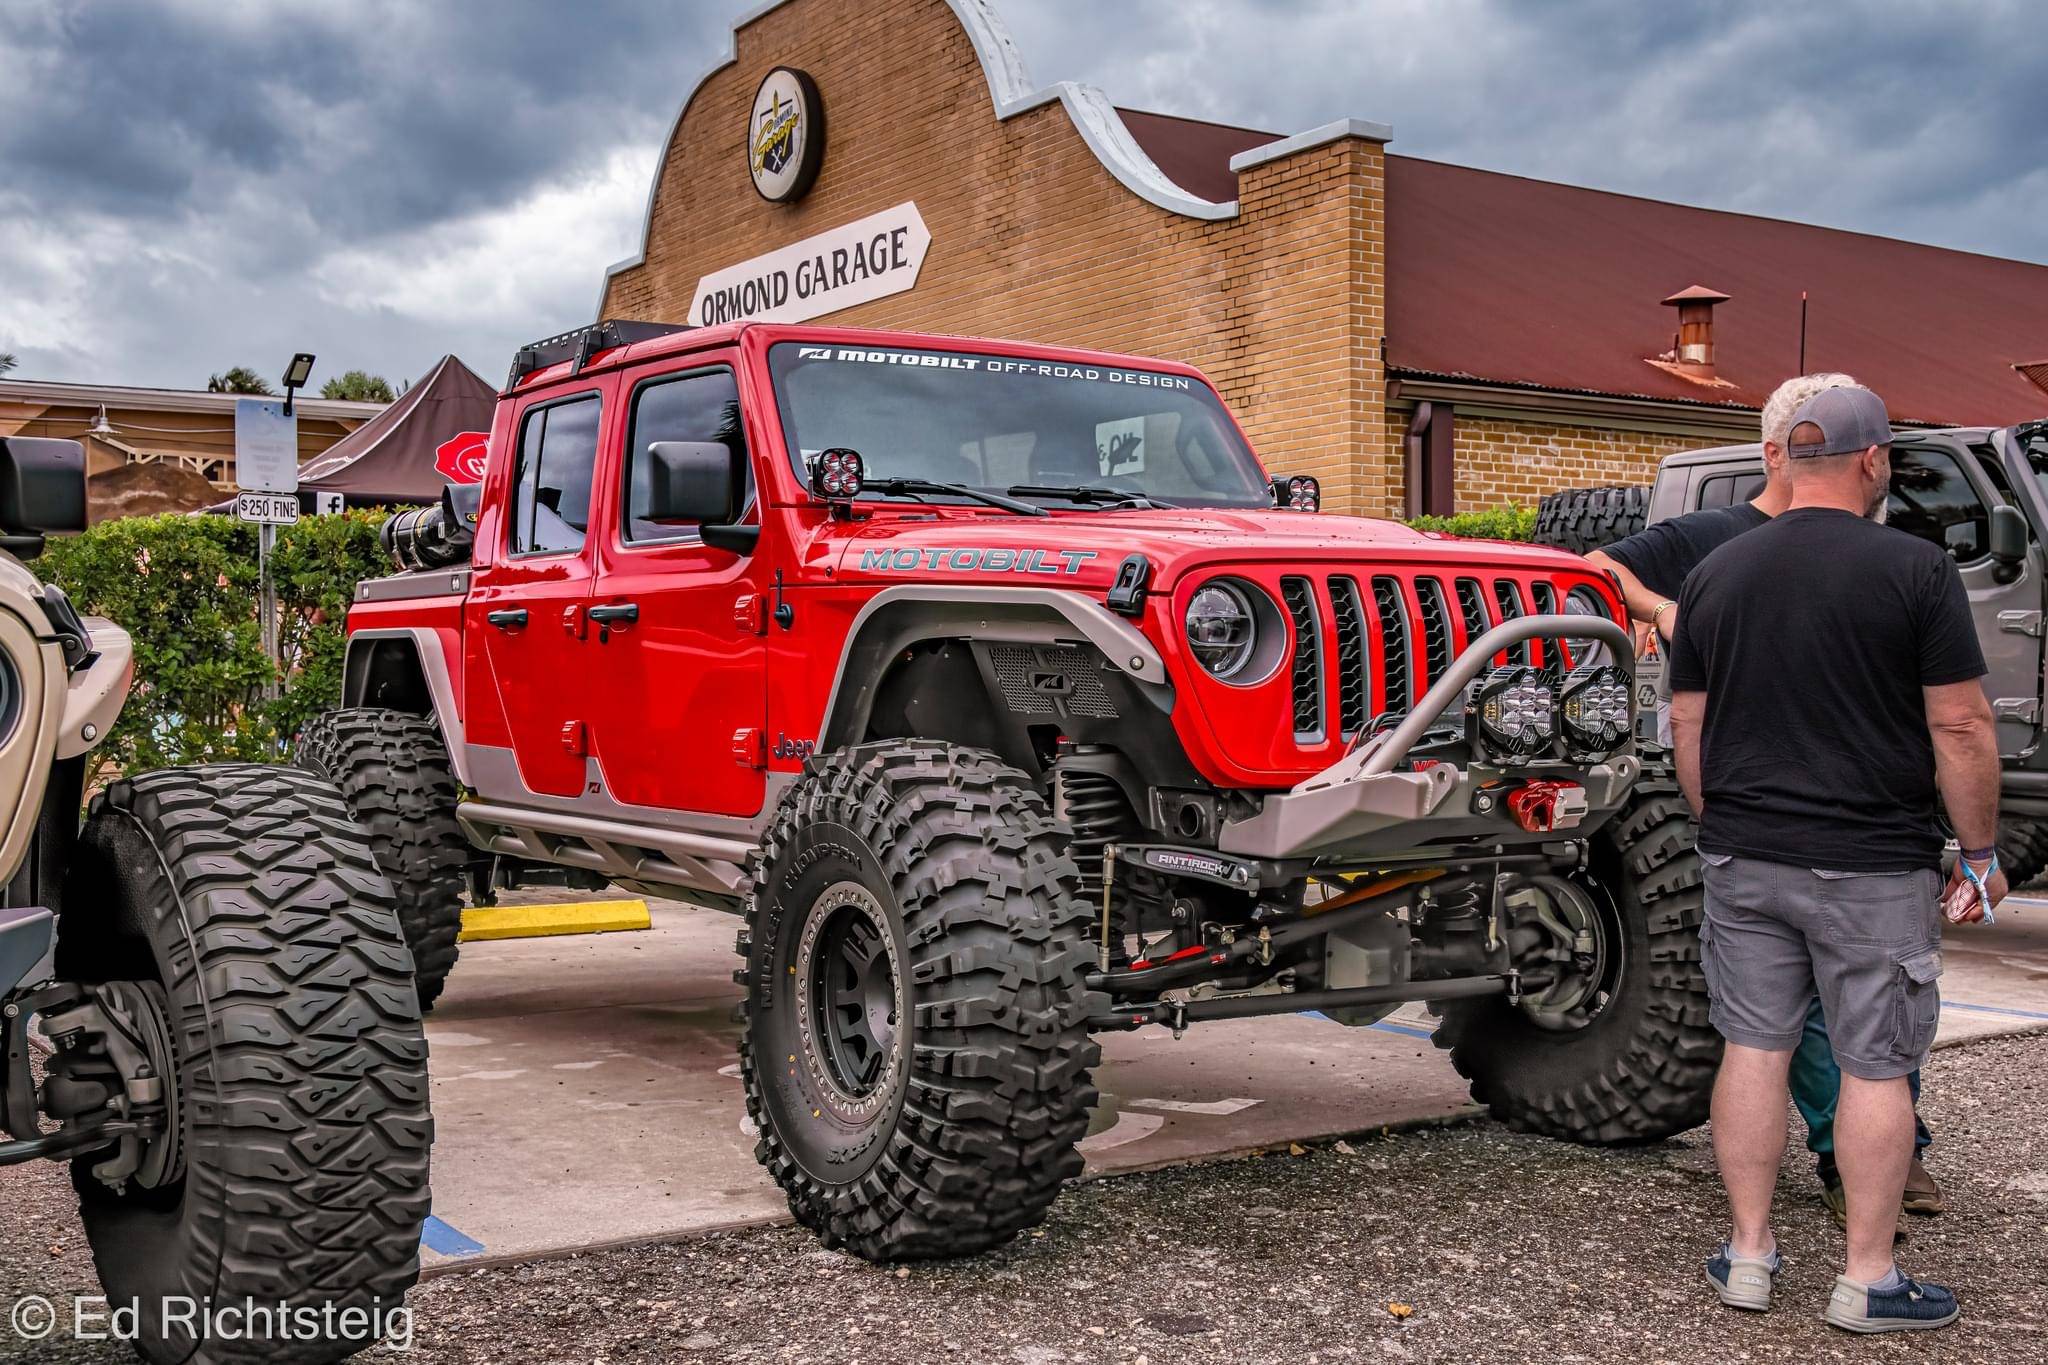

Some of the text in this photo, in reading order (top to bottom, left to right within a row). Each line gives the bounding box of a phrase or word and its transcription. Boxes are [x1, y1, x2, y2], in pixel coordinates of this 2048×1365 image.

[752, 113, 800, 177] Garage
[701, 225, 908, 328] ORMOND GARAGE
[837, 349, 1189, 390] MOTOBILT OFF-ROAD DESIGN
[240, 499, 297, 519] $250 FINE
[858, 548, 1098, 575] MOTOBILT
[772, 732, 816, 760] Jeep
